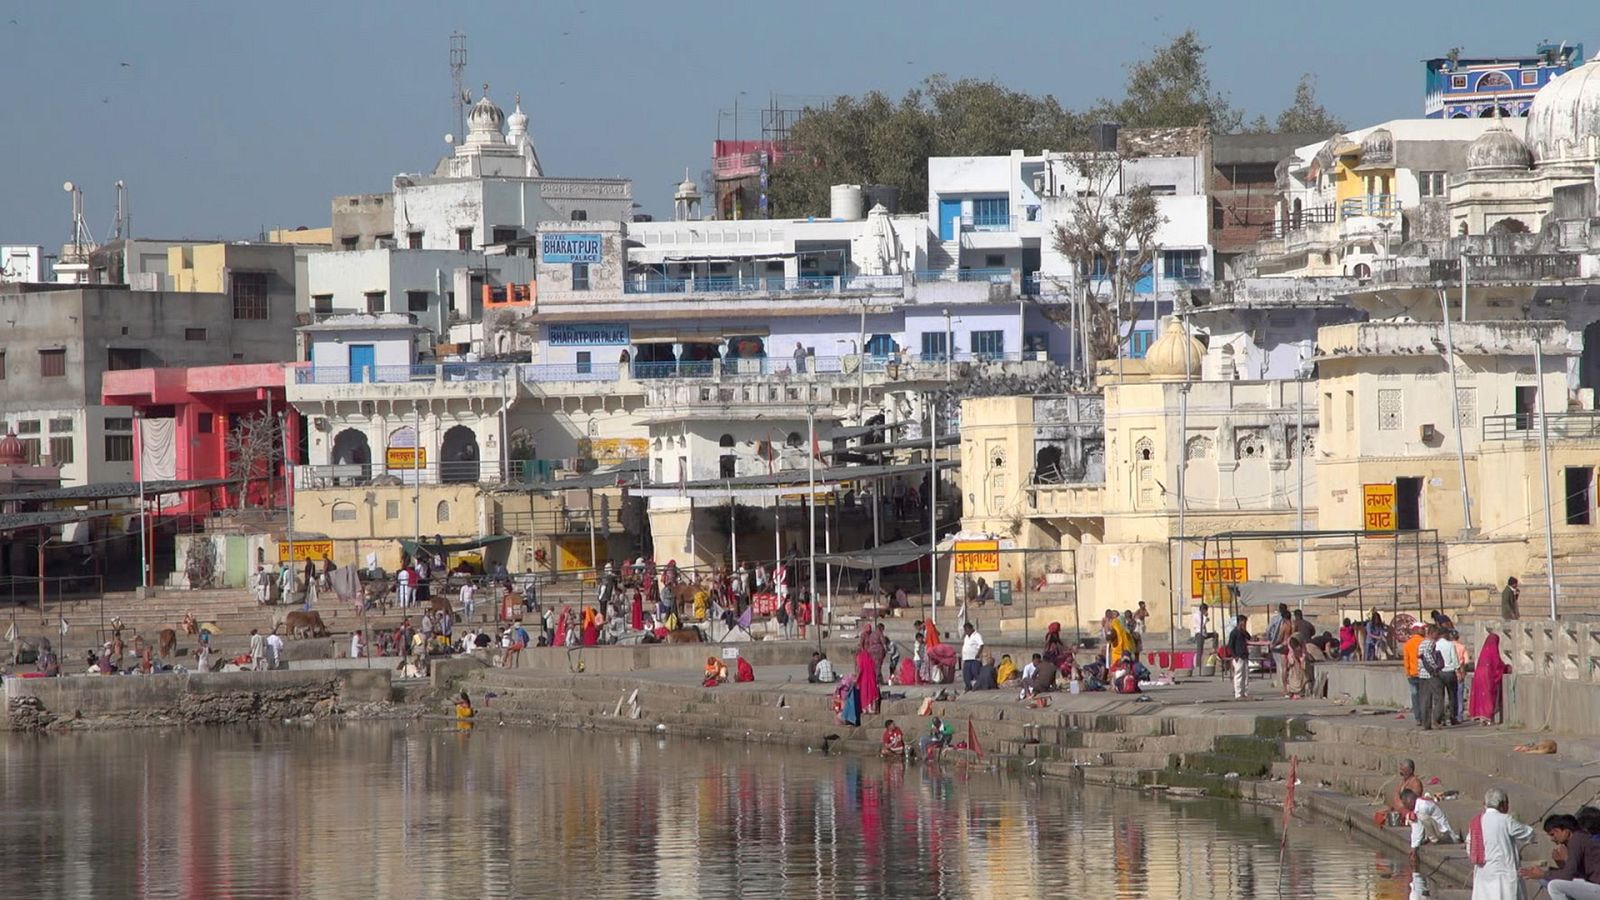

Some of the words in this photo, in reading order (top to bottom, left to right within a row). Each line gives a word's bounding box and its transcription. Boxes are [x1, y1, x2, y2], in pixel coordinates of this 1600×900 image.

[544, 240, 598, 254] BHARATPUR
[550, 331, 600, 344] BHARATPUR
[600, 331, 625, 343] PALACE
[1366, 494, 1393, 509] नगर
[1366, 512, 1391, 528] घाट
[281, 544, 311, 555] भतपुर
[313, 543, 330, 553] घाट
